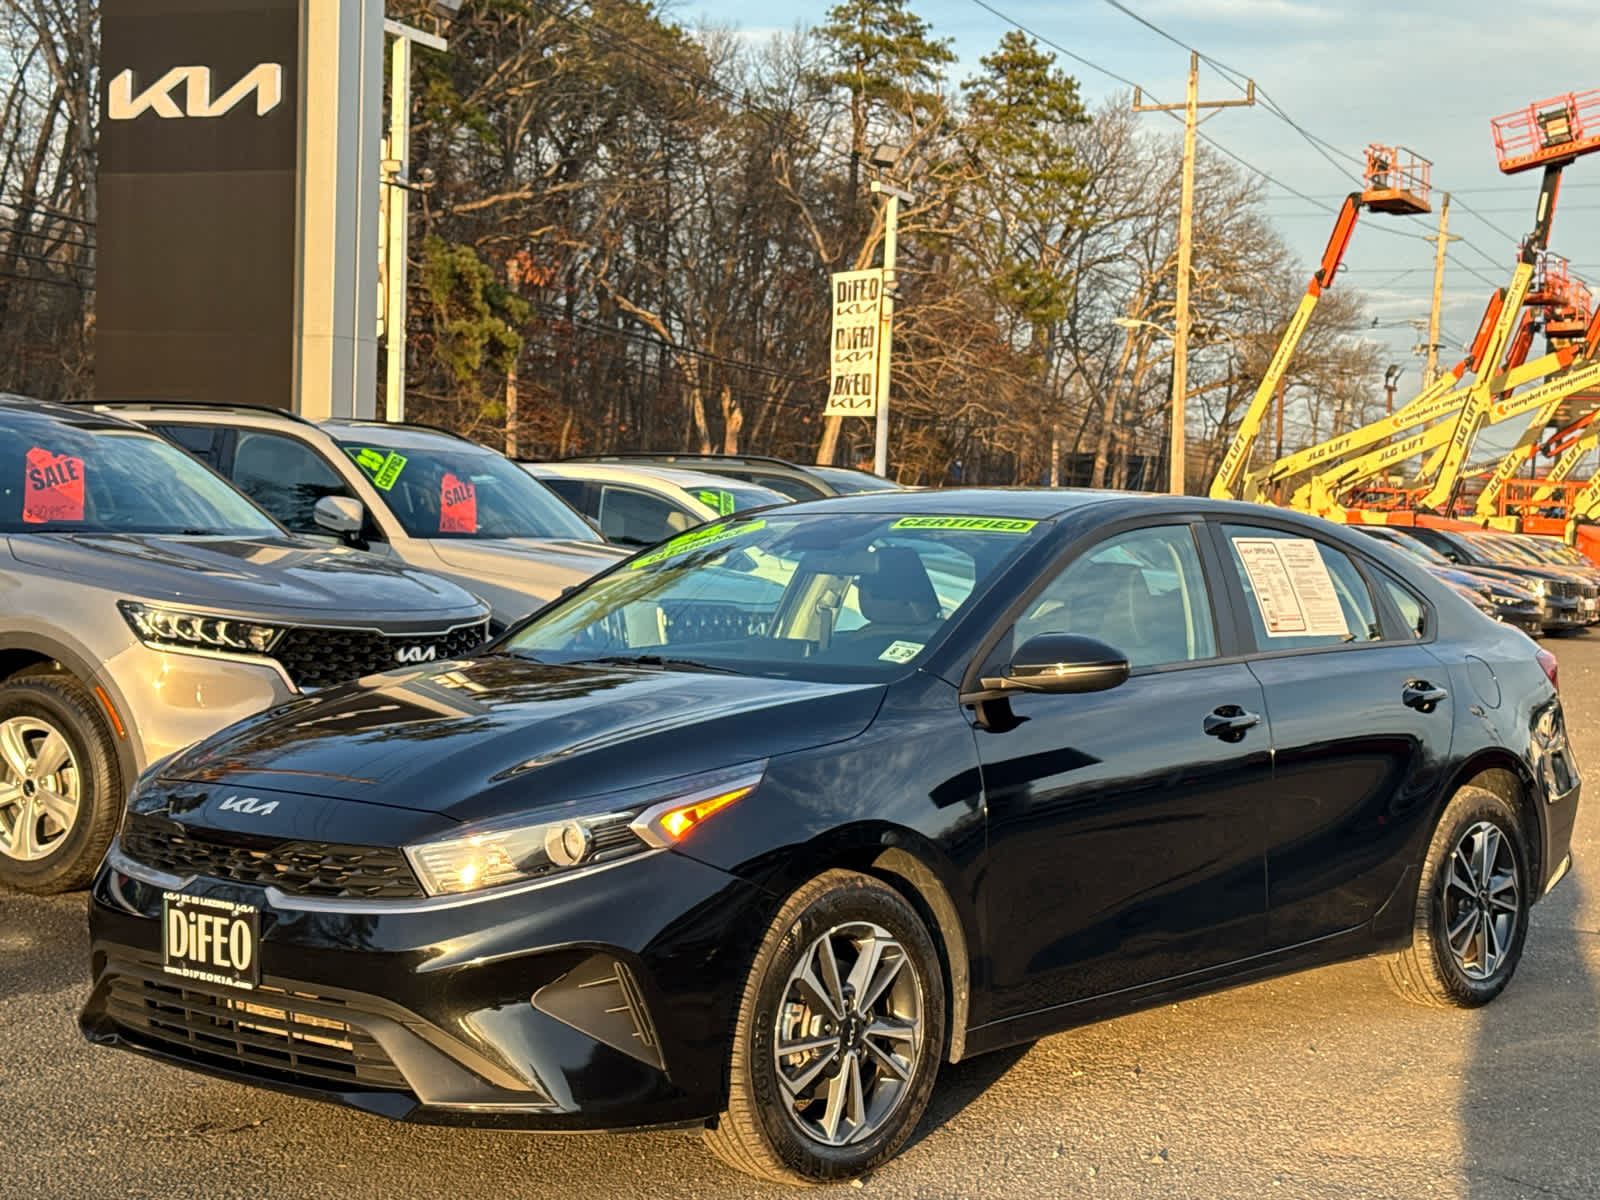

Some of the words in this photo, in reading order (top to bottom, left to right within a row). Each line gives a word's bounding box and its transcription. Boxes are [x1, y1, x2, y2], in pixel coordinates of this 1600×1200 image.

[108, 63, 282, 119] KIA
[837, 277, 879, 304] DiFEO
[1455, 427, 1468, 449] JLG
[1464, 397, 1479, 424] LIFT
[1230, 434, 1245, 460] LIFT
[1307, 449, 1326, 462] JLG
[1329, 438, 1351, 454] LIFT
[1378, 448, 1398, 462] JLG
[1402, 436, 1425, 451] LIFT
[1565, 443, 1582, 464] LIFT
[30, 460, 79, 491] SALE
[1501, 453, 1519, 476] LIFT
[445, 485, 472, 507] SALE
[899, 518, 1028, 530] CERTIFIED
[397, 645, 436, 662] KIA
[219, 795, 280, 816] KIA
[169, 908, 252, 971] DiFEO
